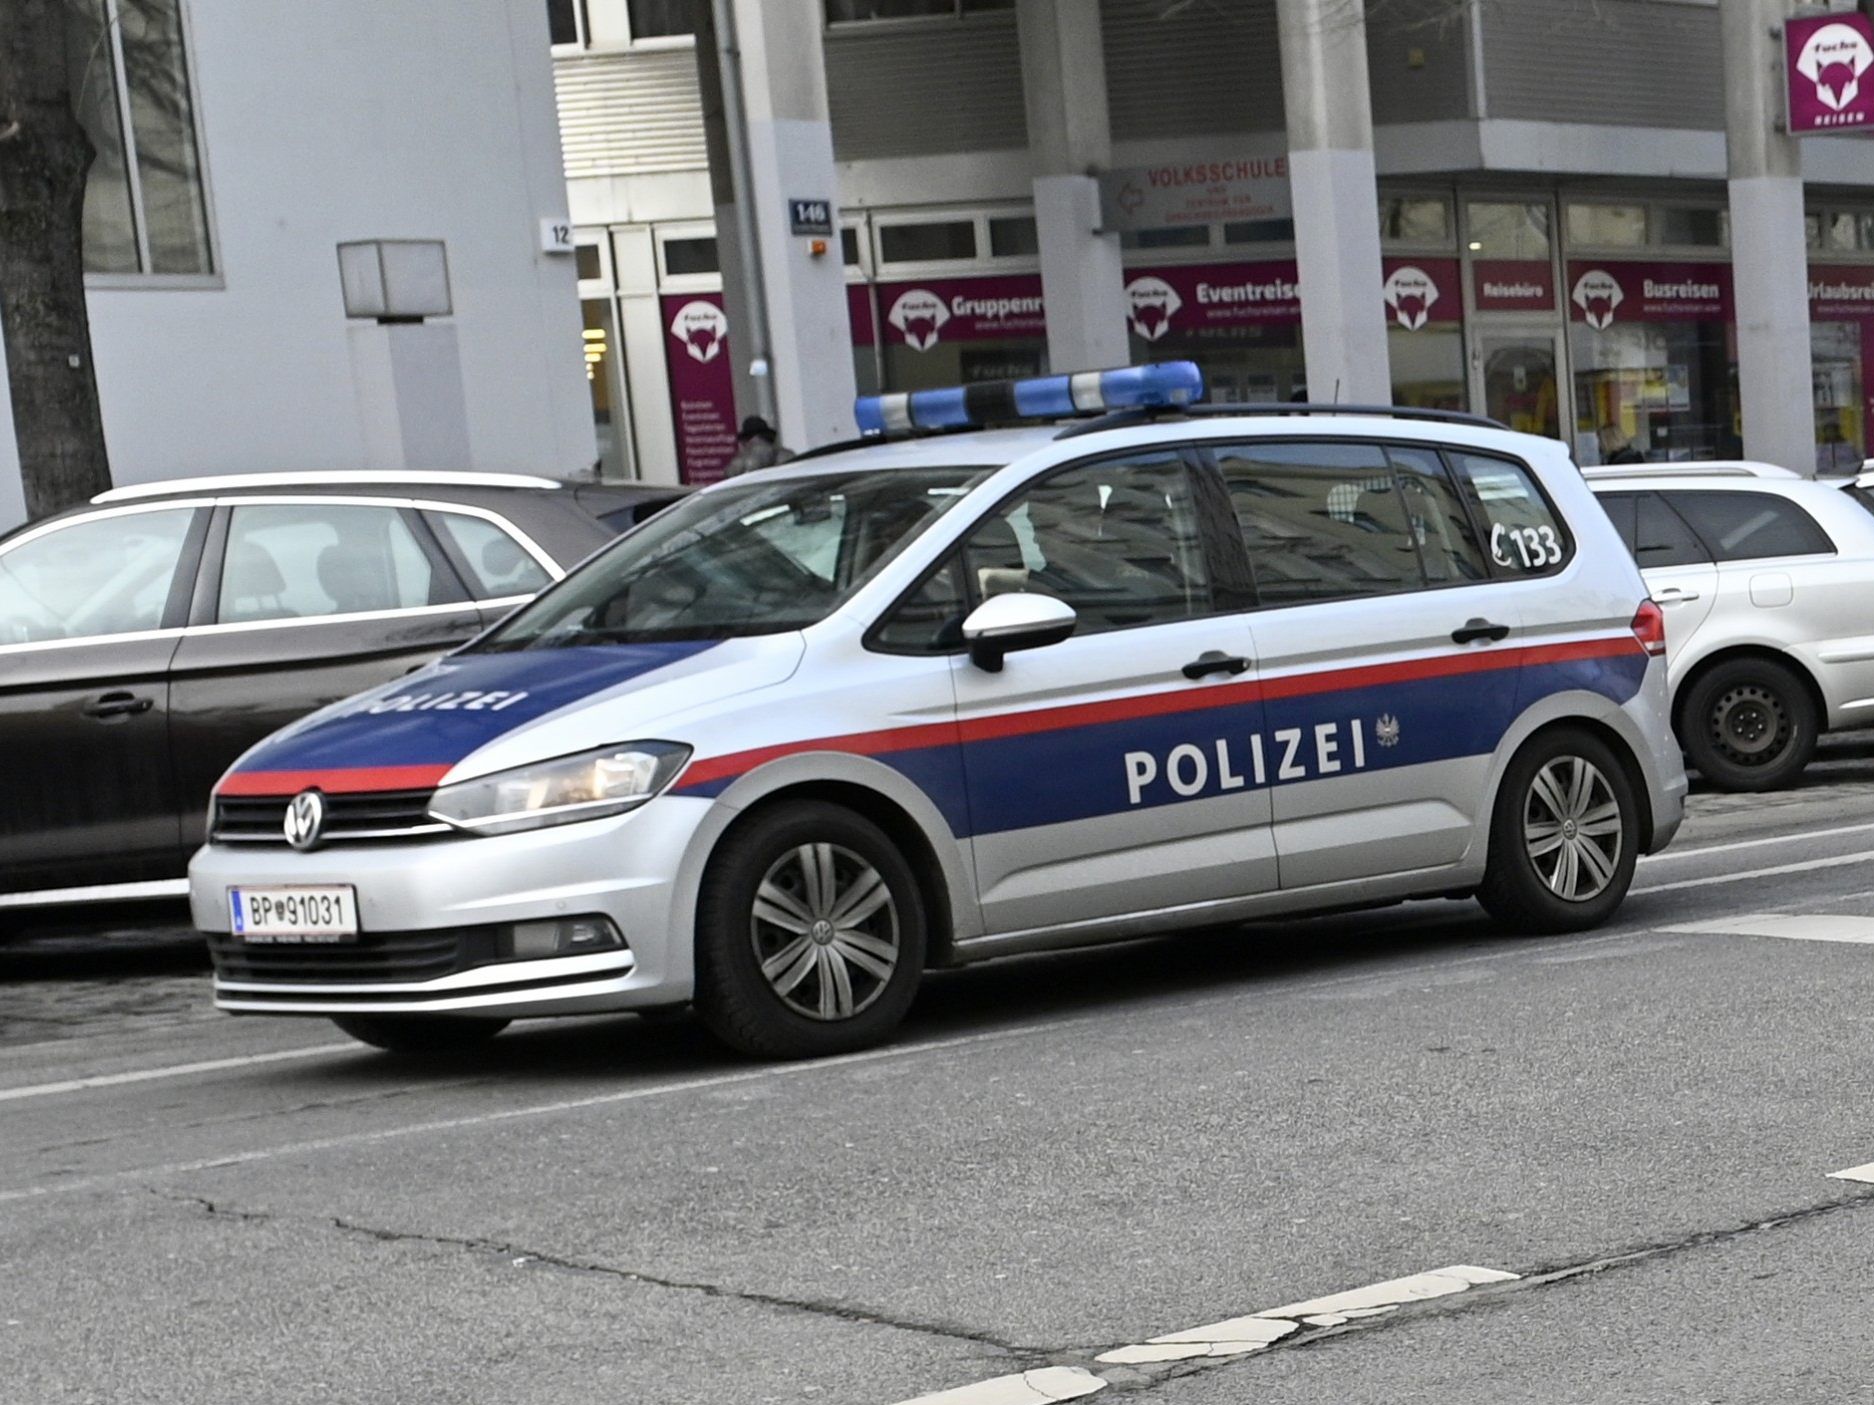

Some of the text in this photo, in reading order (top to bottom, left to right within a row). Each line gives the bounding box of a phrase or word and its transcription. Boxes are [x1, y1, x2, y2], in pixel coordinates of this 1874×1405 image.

[1147, 157, 1286, 187] VOLKSSCHULE
[552, 224, 570, 244] 12
[1482, 281, 1544, 298] Reisebüro
[1642, 279, 1720, 299] Busreisen
[1510, 525, 1562, 567] 133
[1125, 719, 1366, 804] POLIZEI
[250, 895, 343, 926] BP 91031
